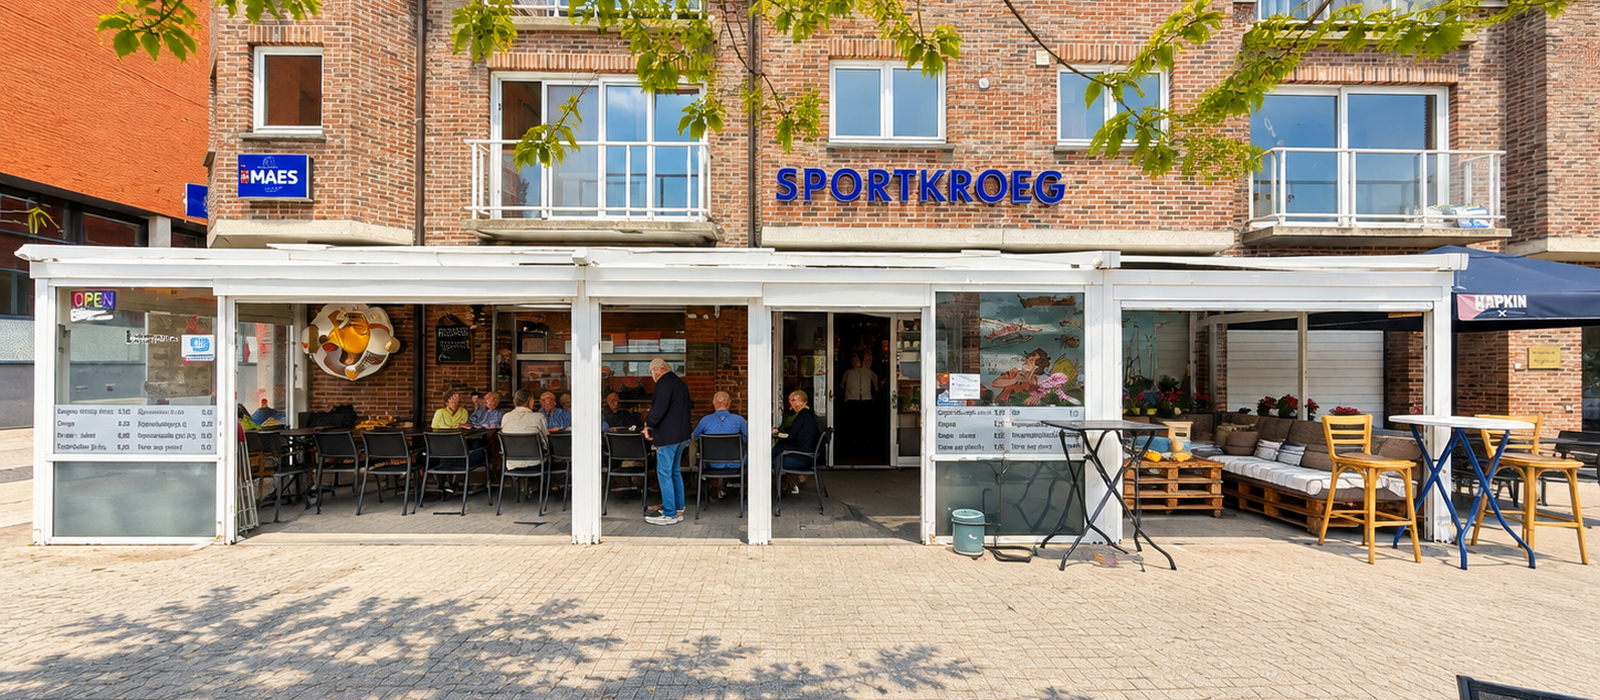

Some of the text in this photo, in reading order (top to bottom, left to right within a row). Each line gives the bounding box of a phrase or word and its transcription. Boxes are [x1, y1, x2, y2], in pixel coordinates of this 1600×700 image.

[250, 169, 299, 185] MAES
[775, 167, 1066, 205] SPORTKROEG
[73, 291, 115, 308] OPEN
[1475, 294, 1527, 309] HAPKIN
